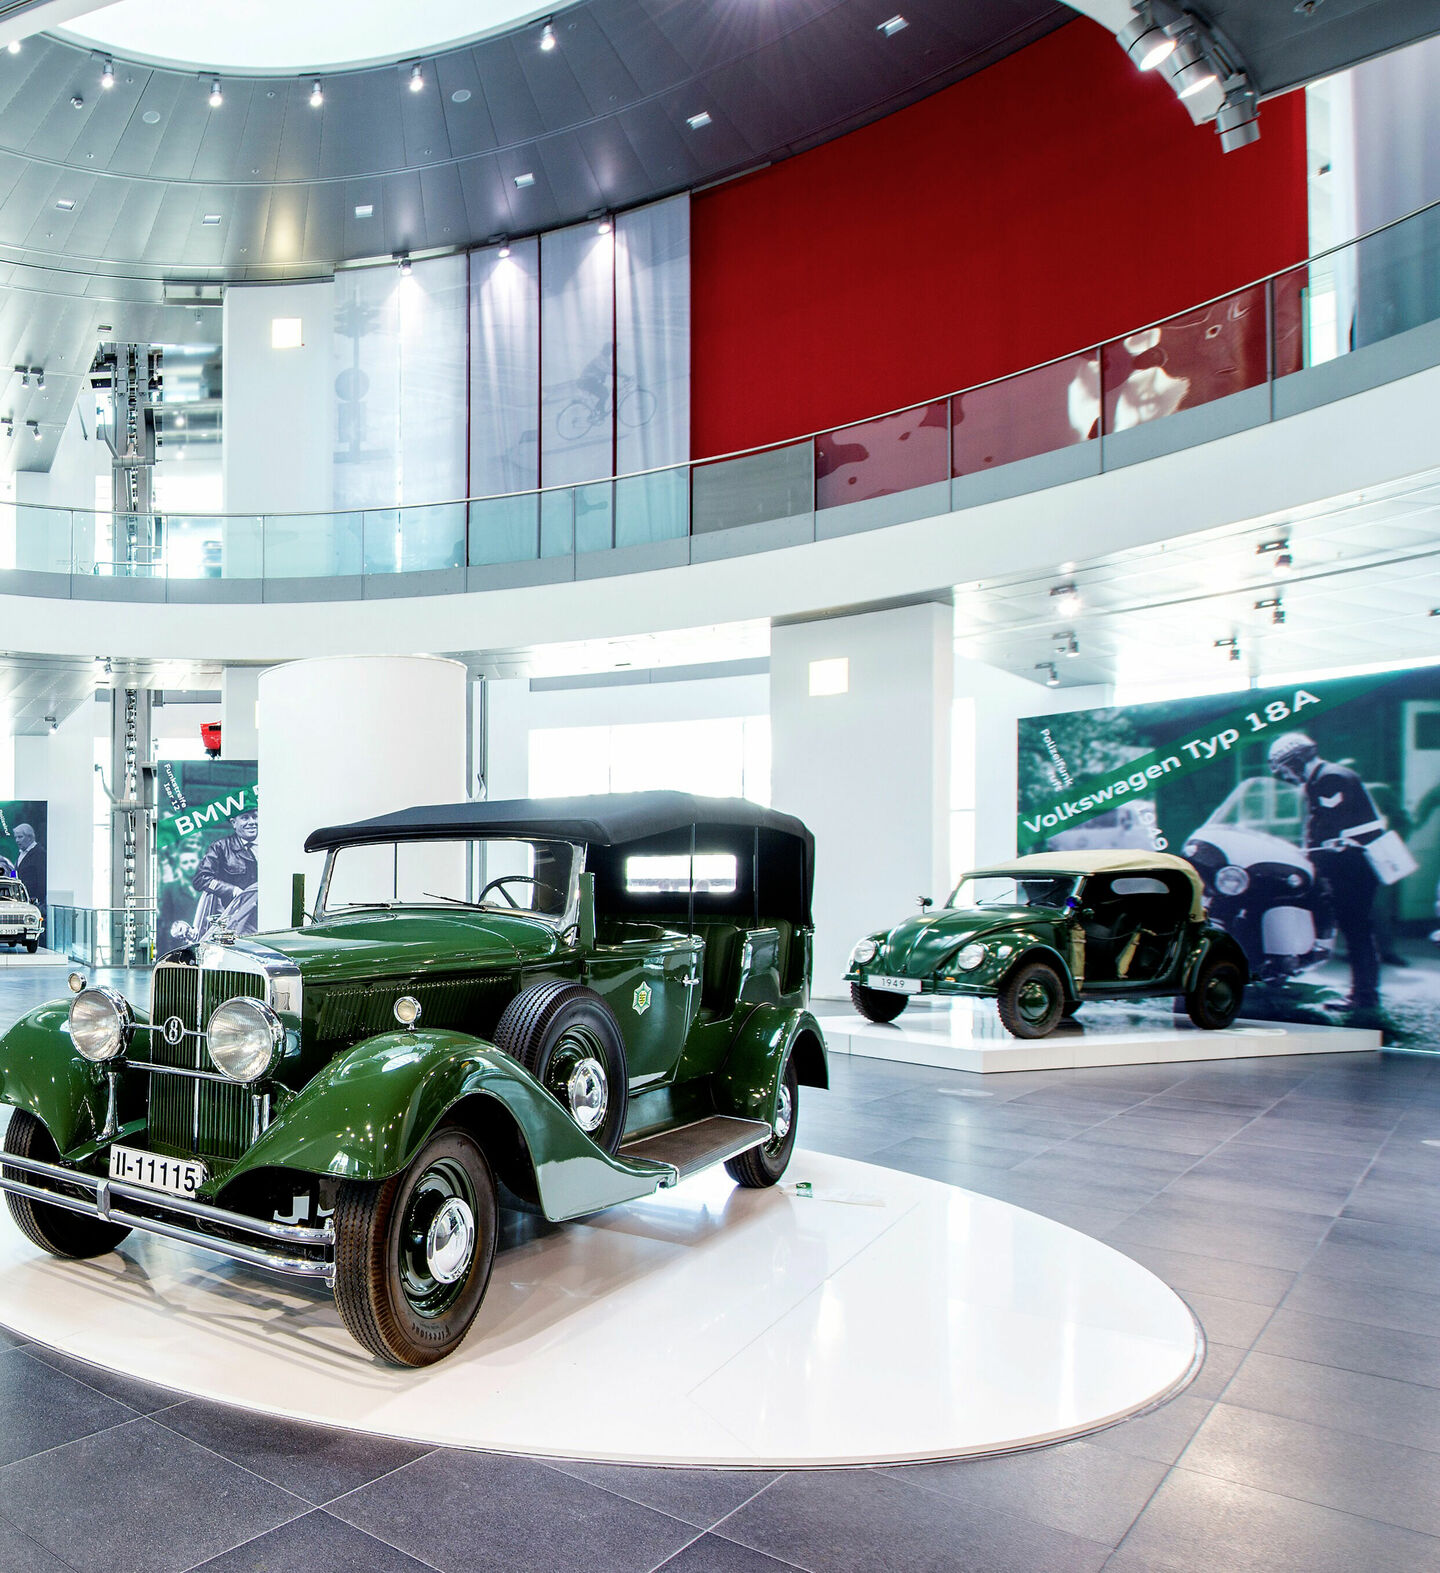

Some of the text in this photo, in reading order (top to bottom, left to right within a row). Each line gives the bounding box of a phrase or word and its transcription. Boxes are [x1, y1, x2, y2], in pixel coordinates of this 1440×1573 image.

[1023, 689, 1321, 833] Volkswagen Typ 18A
[163, 782, 180, 811] Isar 12
[164, 763, 187, 808] Funkstreife
[174, 791, 244, 836] BMW
[881, 977, 905, 988] 1949
[169, 1019, 178, 1042] 8
